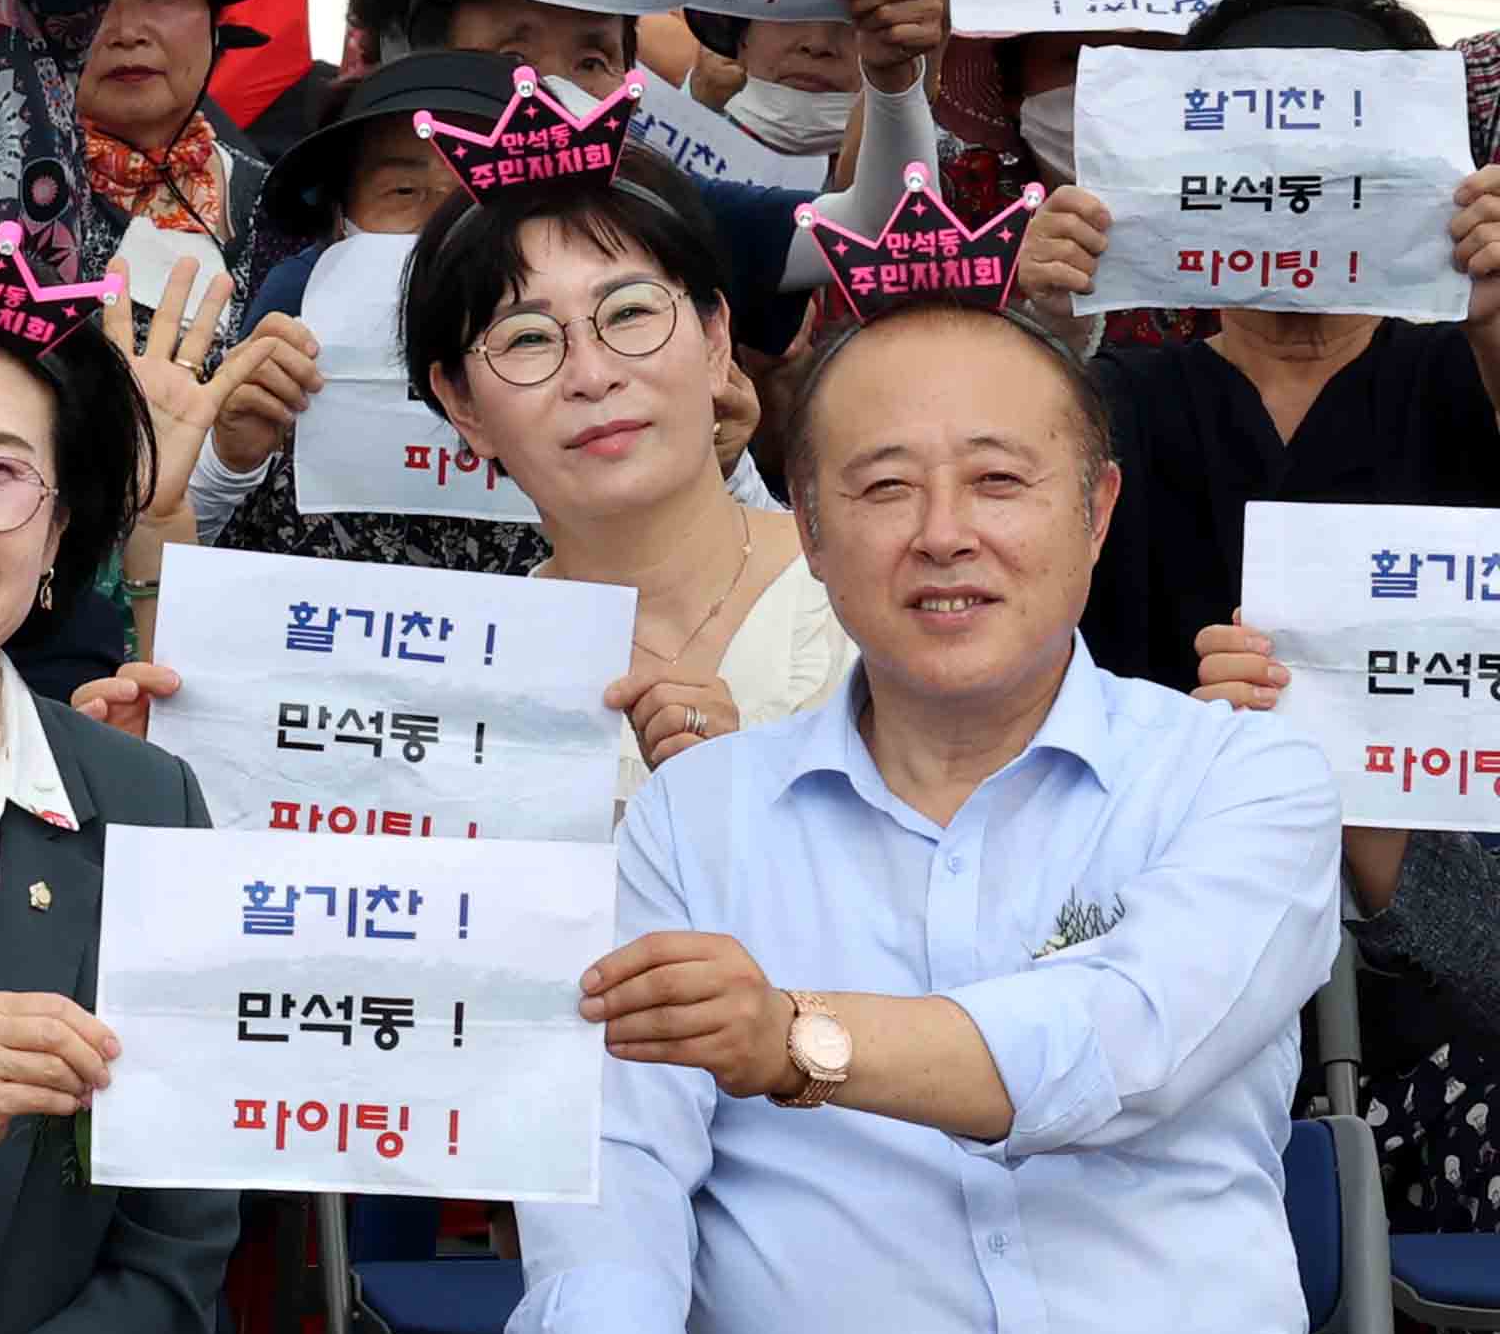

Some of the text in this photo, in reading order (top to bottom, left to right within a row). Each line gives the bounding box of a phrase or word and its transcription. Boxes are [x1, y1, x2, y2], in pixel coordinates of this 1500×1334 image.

[500, 122, 573, 153] 만석동
[471, 142, 612, 189] 주민자치회
[887, 227, 962, 259] 만석동
[850, 256, 1002, 295] 주민자치회
